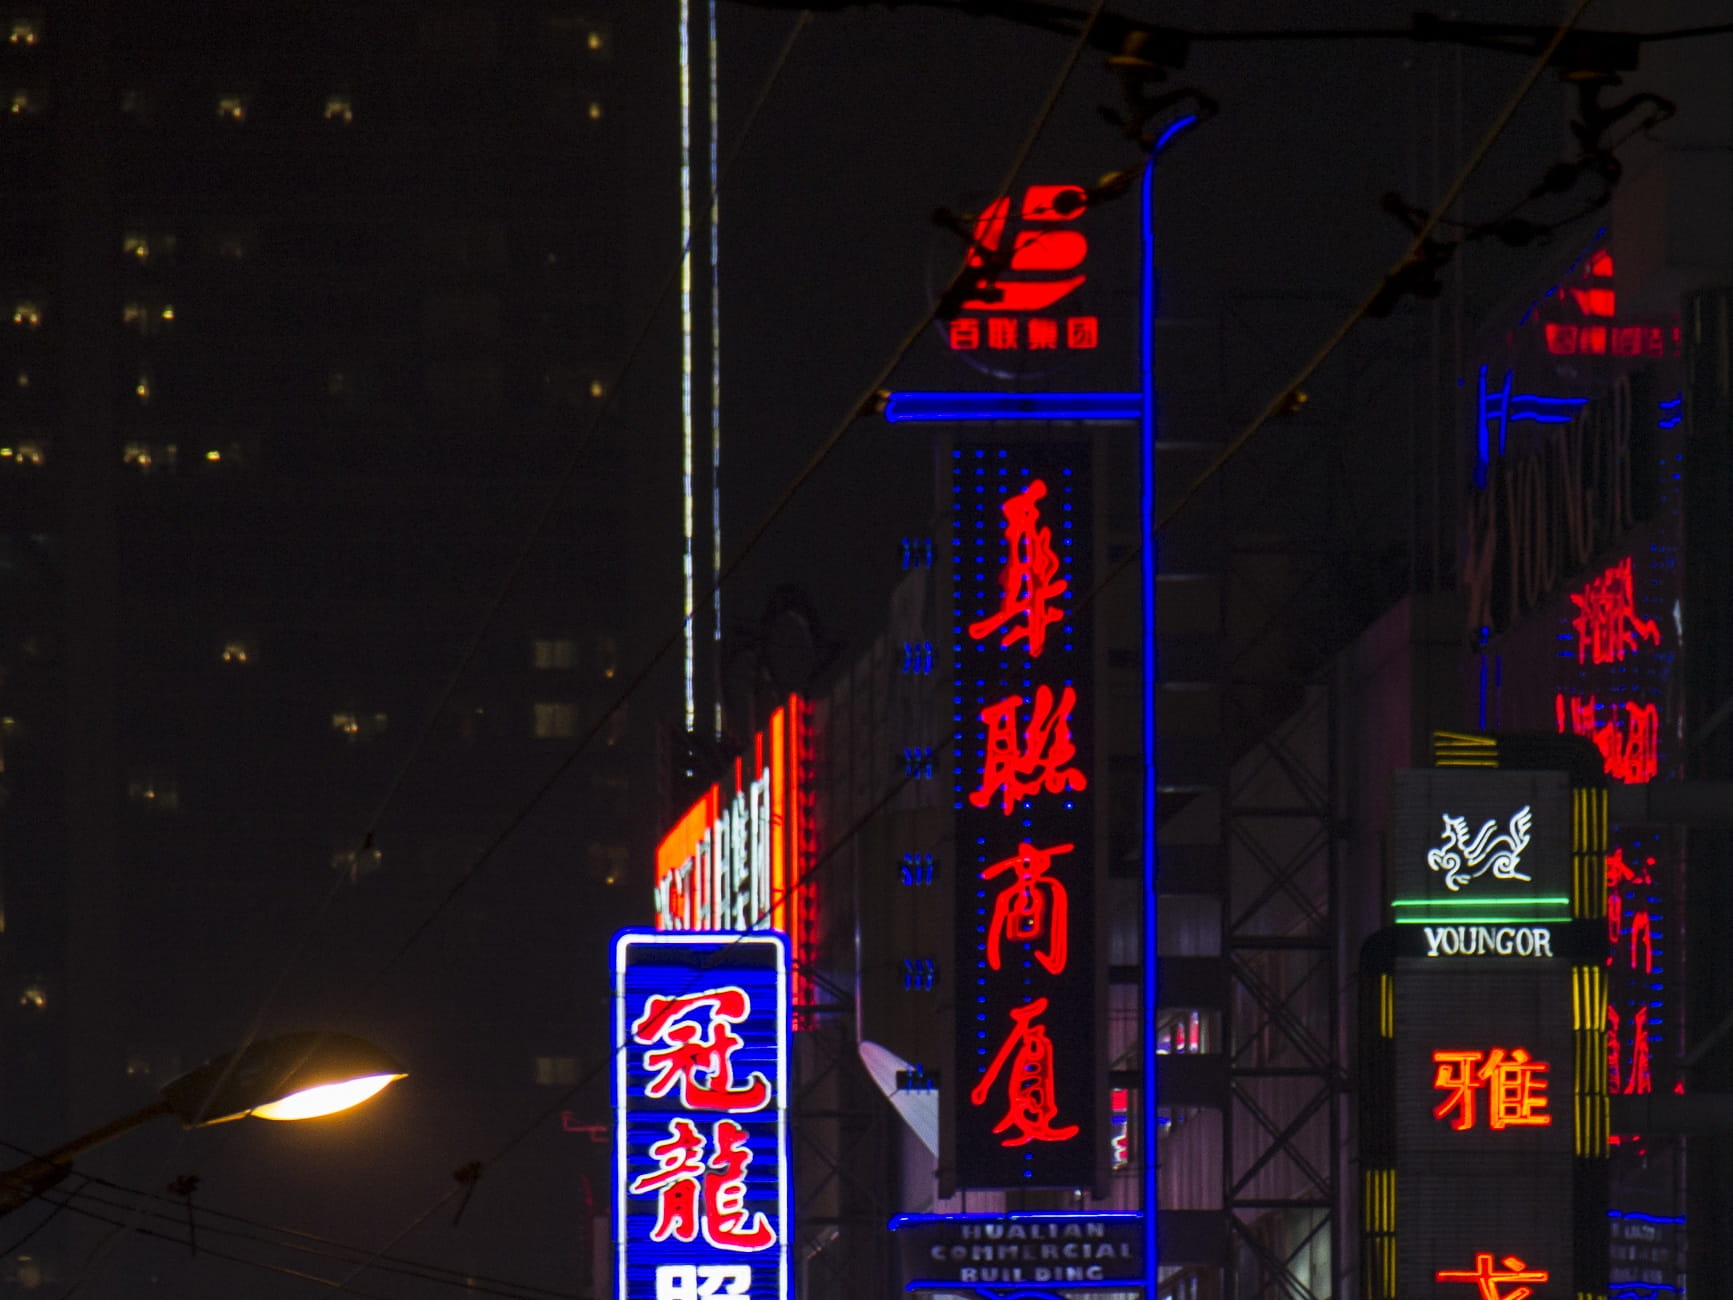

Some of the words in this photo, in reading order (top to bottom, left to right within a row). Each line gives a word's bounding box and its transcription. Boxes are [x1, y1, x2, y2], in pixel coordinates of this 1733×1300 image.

[1423, 926, 1554, 958] YOUNGOR
[961, 1222, 1105, 1240] HUALIAN
[930, 1243, 1134, 1262] COMMERCIAL
